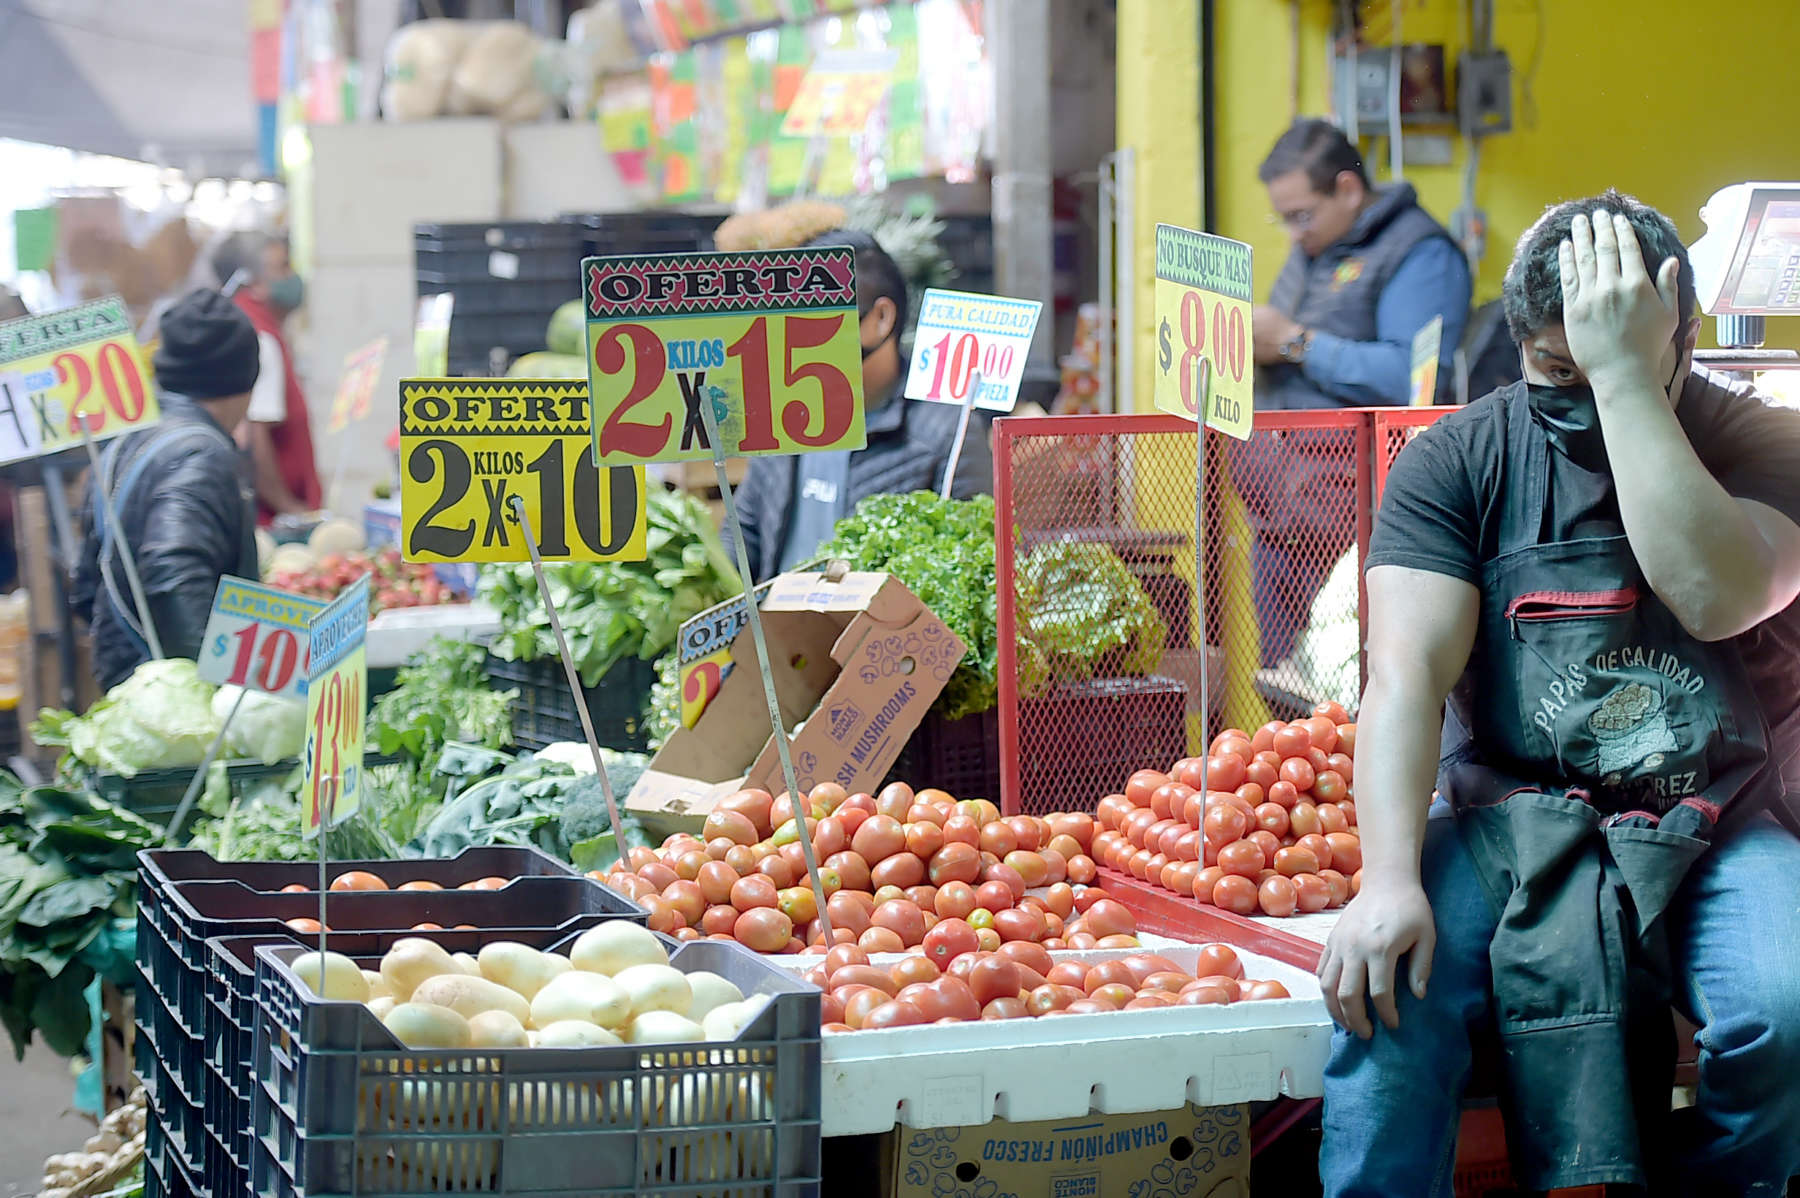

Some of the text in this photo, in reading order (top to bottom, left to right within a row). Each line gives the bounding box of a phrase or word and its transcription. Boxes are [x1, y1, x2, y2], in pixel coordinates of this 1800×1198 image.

[1160, 240, 1248, 285] NO BUSQUE MAS
[600, 265, 844, 302] OFERTA
[929, 303, 1030, 329] PURA CALIDAD
[667, 339, 724, 369] KILOS
[53, 343, 145, 435] 20
[595, 323, 672, 458] 2
[977, 382, 1009, 401] PIEZA
[1214, 394, 1240, 424] KILO
[676, 372, 711, 450] X
[474, 451, 523, 475] KILOS
[408, 439, 476, 557] 2
[482, 479, 510, 547] X
[1534, 646, 1705, 732] PAPAS DE CALIDAD
[830, 706, 857, 737] MONTE
[836, 711, 860, 741] BLANCO
[850, 681, 916, 764] MUSHROOMS
[983, 1121, 1168, 1164] CHAMPIÑÓN FRESCO
[1055, 1176, 1097, 1189] BLANCO
